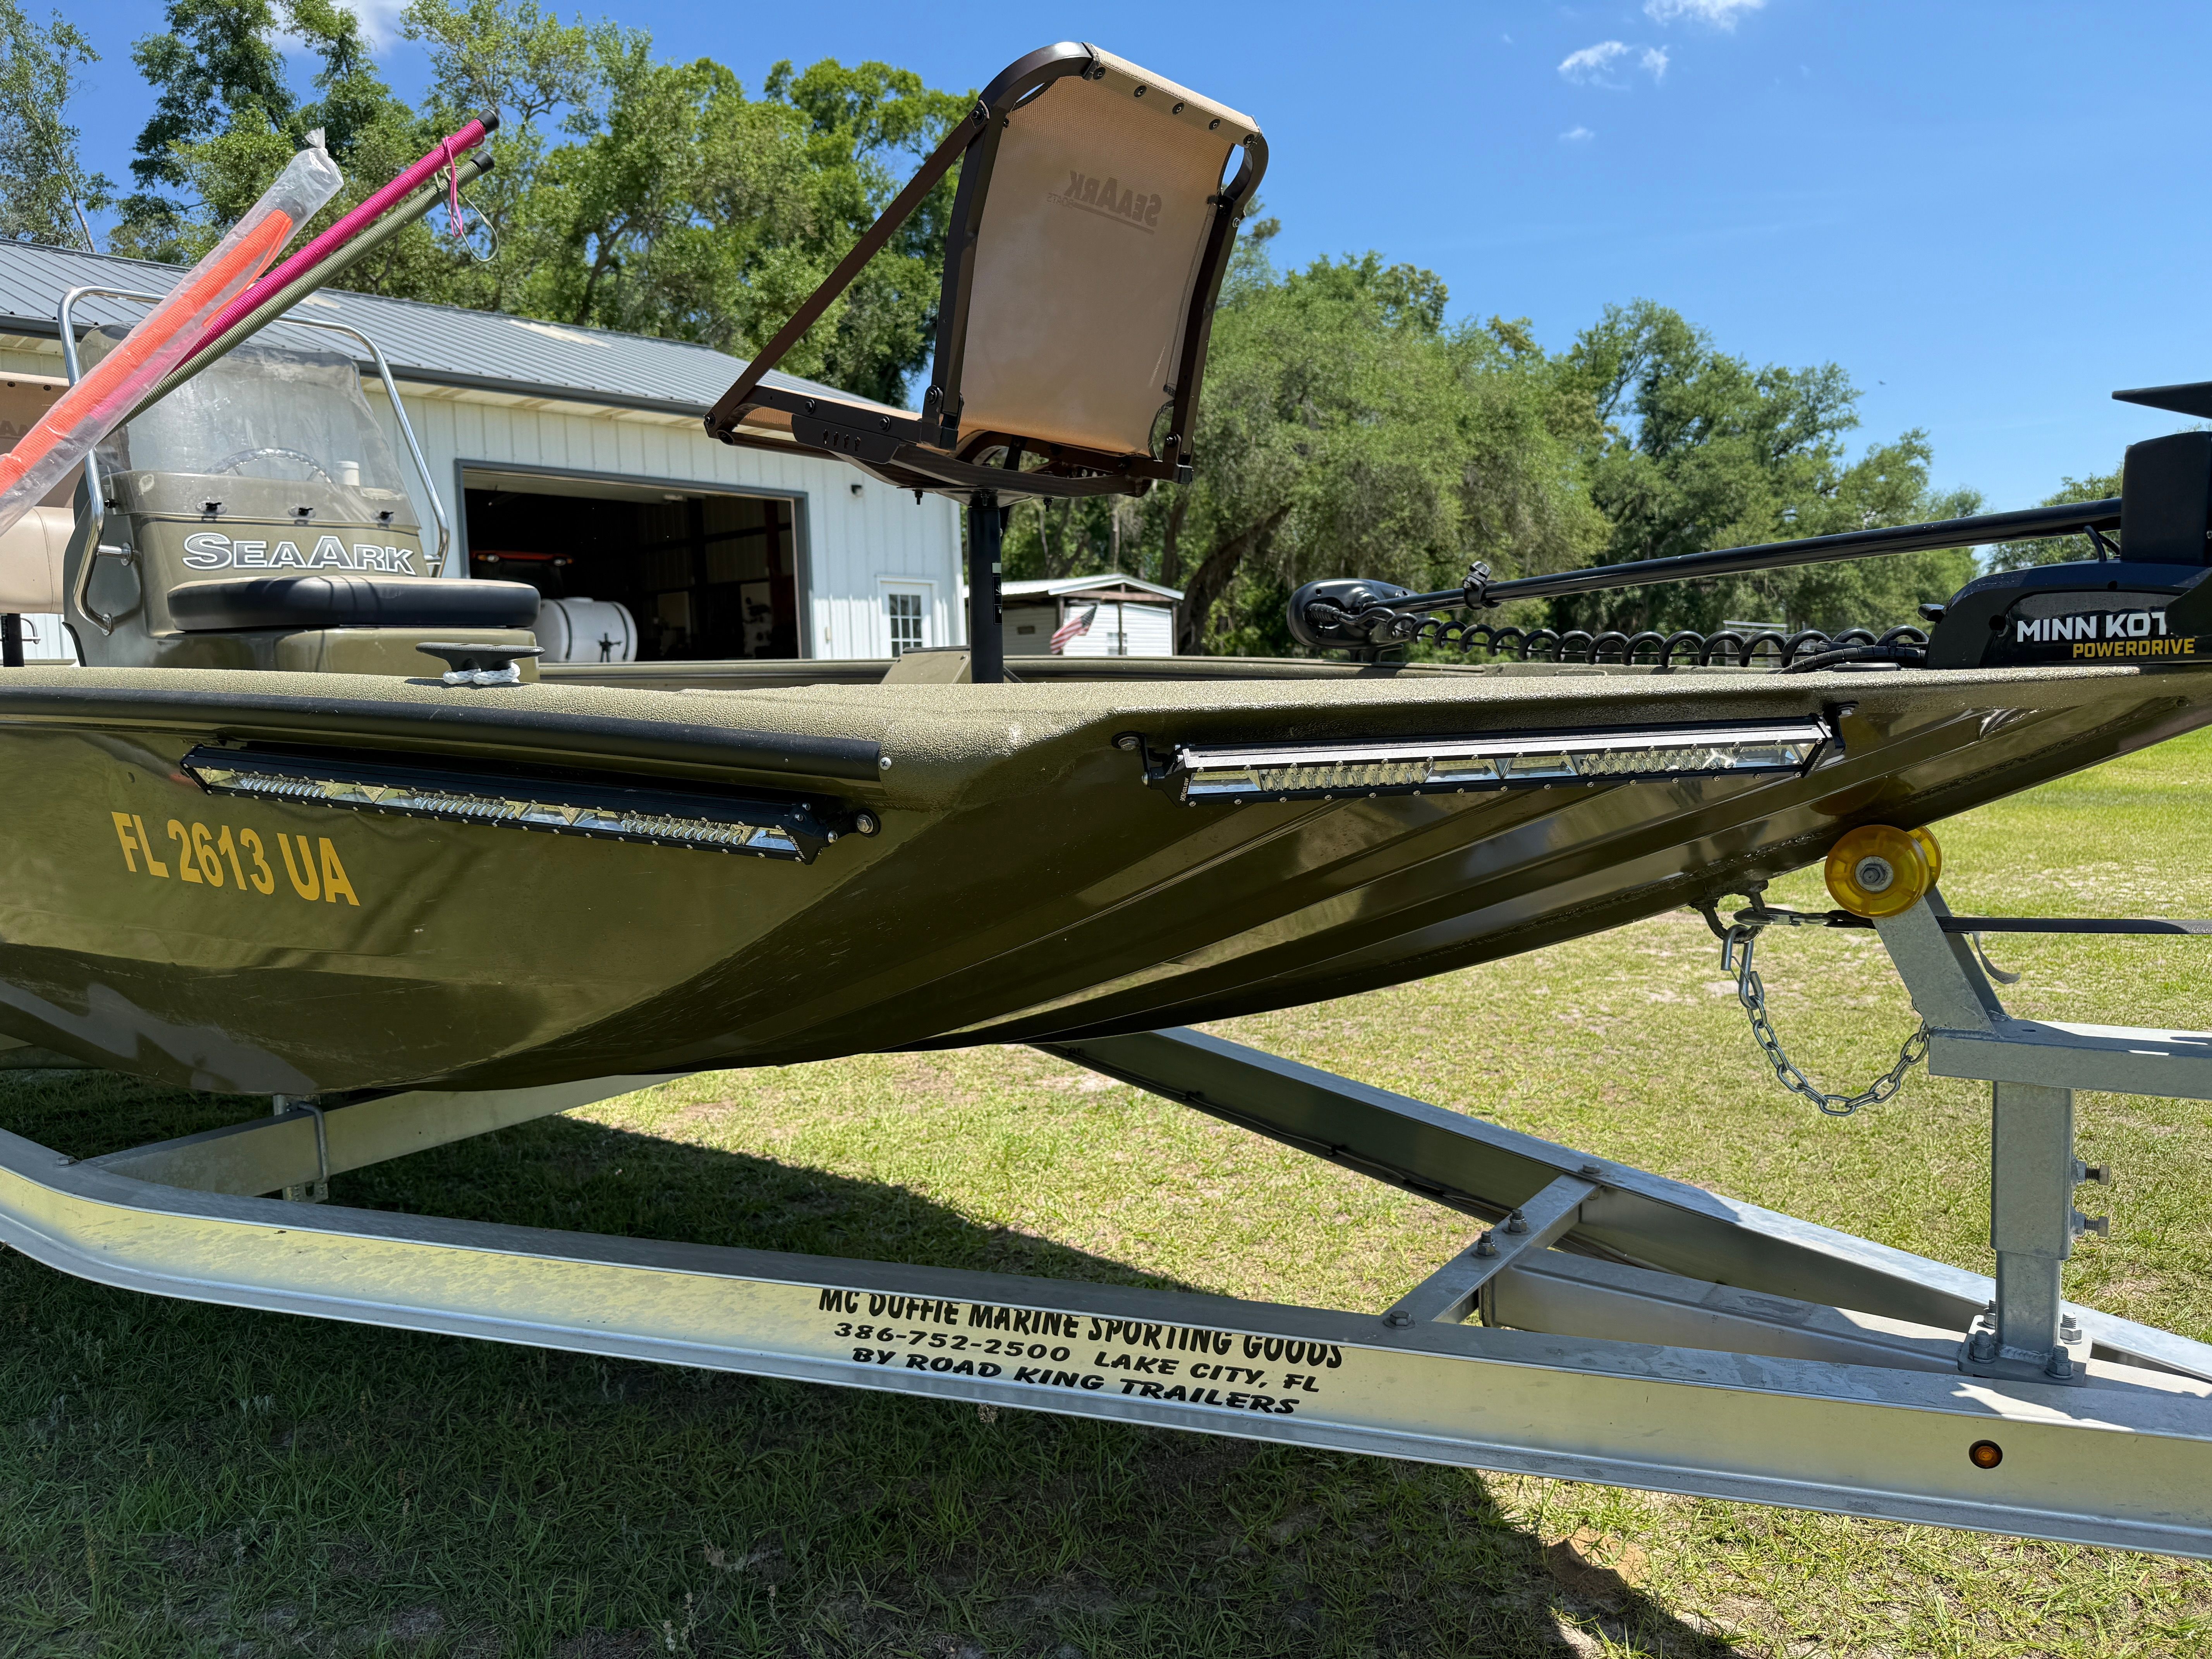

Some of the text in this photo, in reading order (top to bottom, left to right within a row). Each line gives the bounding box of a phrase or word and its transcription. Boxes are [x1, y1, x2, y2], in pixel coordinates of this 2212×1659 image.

[2017, 612, 2167, 642] MINN KOT
[2073, 638, 2195, 658] POWERDRIVE
[111, 812, 361, 906] FL 2613 UA
[819, 1288, 1345, 1369] MC DUFFIE MARINE SPORTING GOODS
[834, 1322, 1319, 1393] 386-752-2500 LAKE CITY, FL
[852, 1347, 1300, 1414] BY ROAD KING TRAILERS
